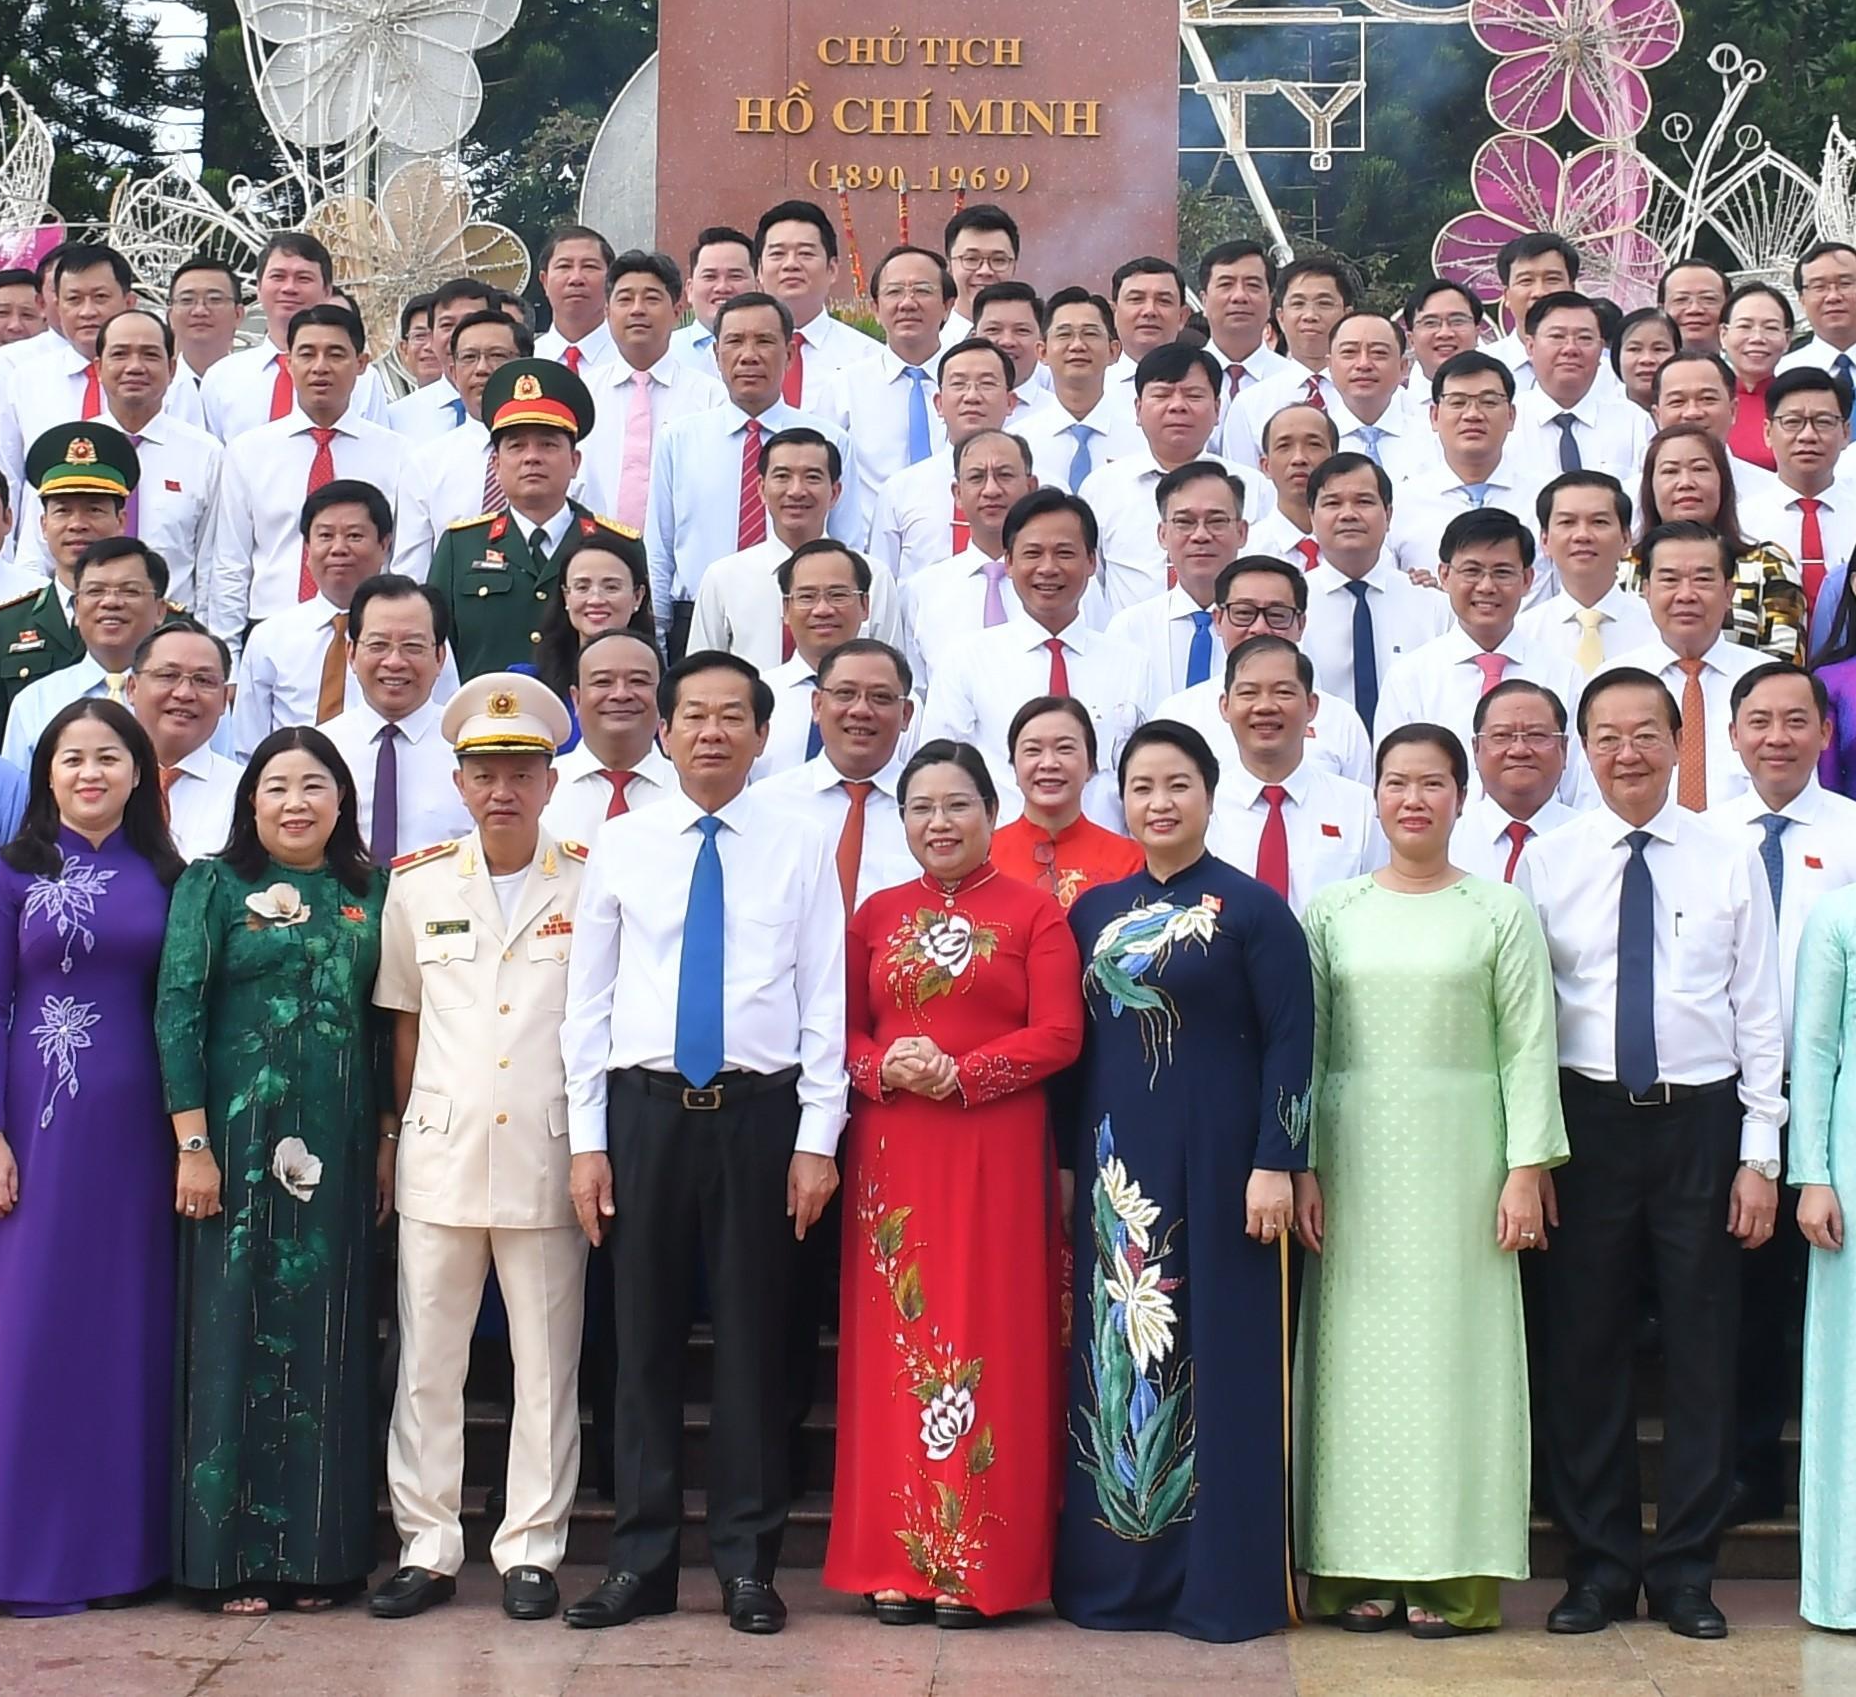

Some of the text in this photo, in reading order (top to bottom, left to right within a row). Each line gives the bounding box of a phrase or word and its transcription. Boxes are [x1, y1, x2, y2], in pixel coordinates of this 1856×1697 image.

[816, 24, 1023, 73] CHỦ TỊCH
[734, 80, 1101, 137] HỒ CHÍ MINH
